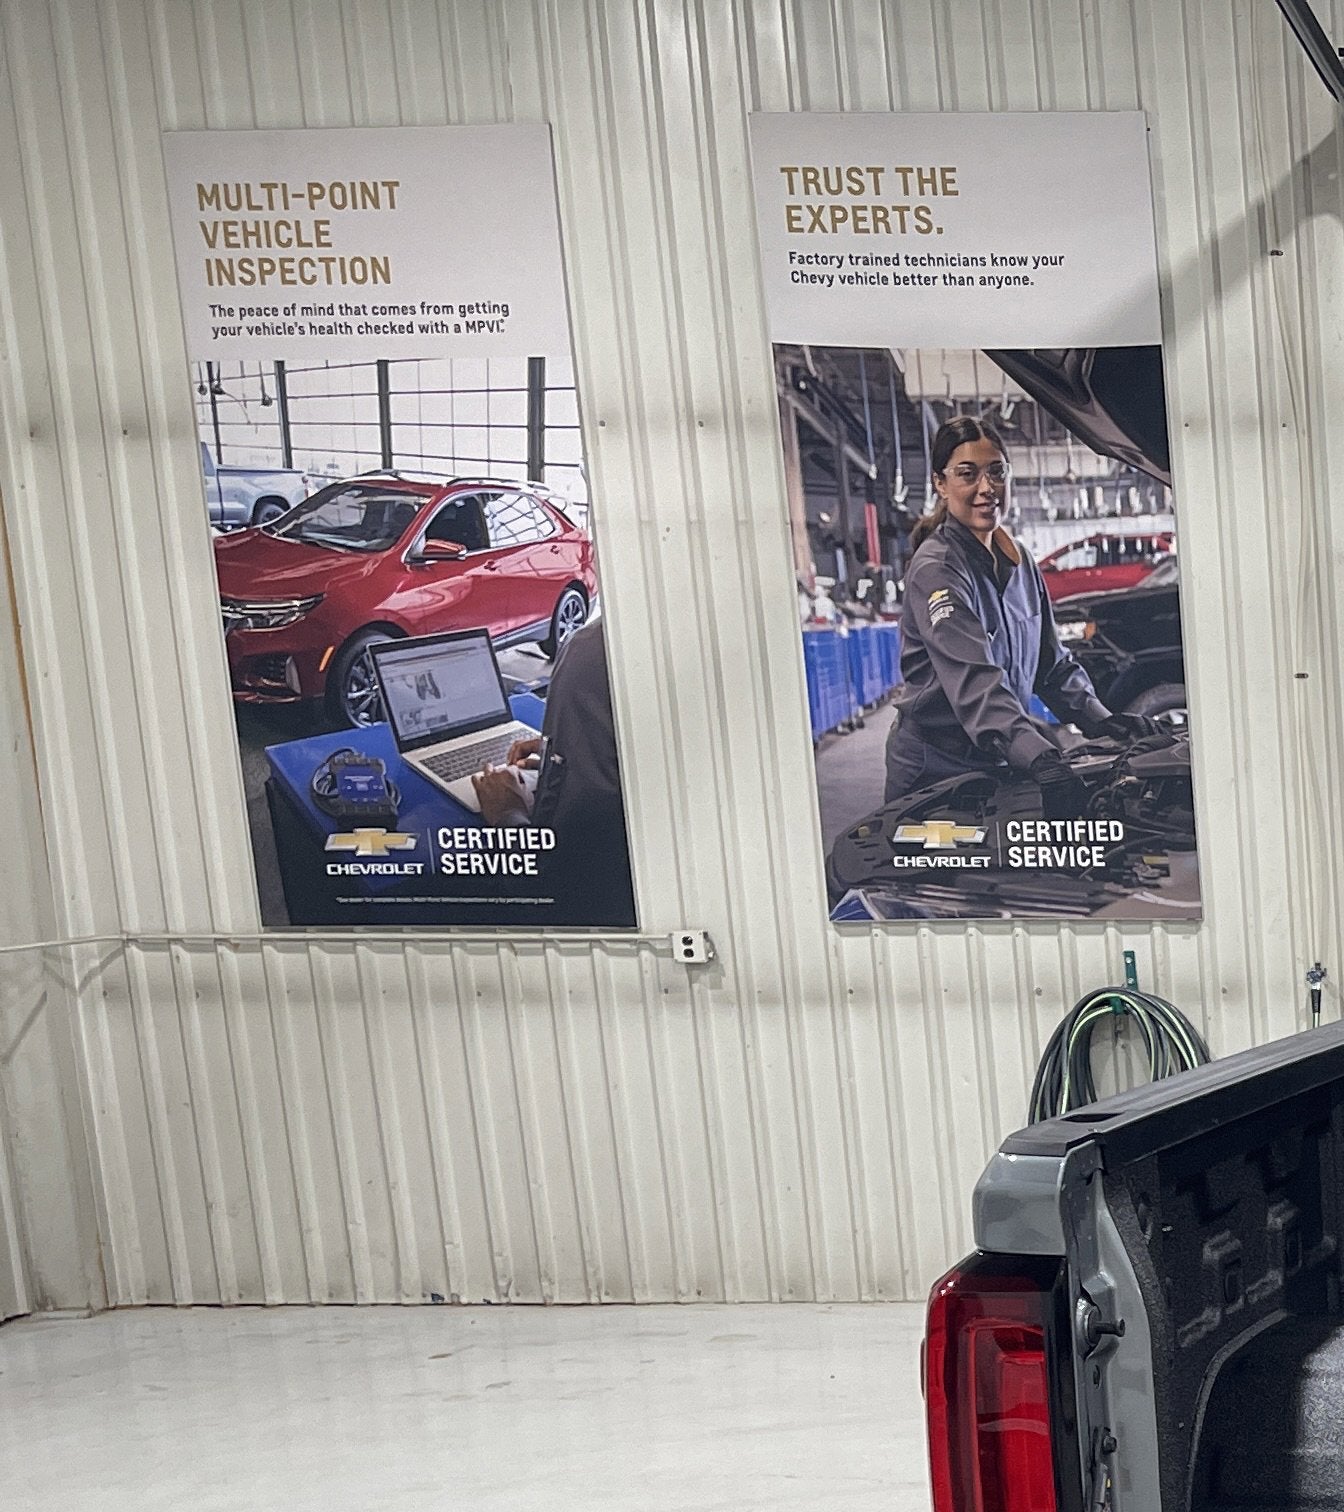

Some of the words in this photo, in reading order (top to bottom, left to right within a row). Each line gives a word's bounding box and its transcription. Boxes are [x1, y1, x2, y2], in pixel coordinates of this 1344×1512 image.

[780, 166, 885, 196] TRUST
[895, 166, 959, 197] THE
[196, 180, 400, 212] MULTI-POINT
[785, 204, 944, 235] EXPERTS.
[199, 219, 333, 249] VEHICLE
[205, 256, 392, 287] INSPECTION
[789, 251, 844, 269] Factory
[849, 252, 900, 267] trained
[904, 252, 987, 267] technicians
[991, 253, 1028, 267] know
[1032, 254, 1065, 269] your
[790, 270, 834, 287] Chevy
[838, 270, 889, 286] vehicle
[893, 271, 938, 286] better
[942, 272, 974, 286] than
[979, 274, 1034, 289] anyone.
[208, 304, 235, 318] The
[238, 305, 279, 320] peace
[283, 303, 297, 317] of
[300, 303, 334, 316] mind
[338, 302, 368, 316] that
[371, 304, 416, 316] comes
[420, 301, 454, 315] from
[458, 301, 510, 318] getting
[211, 325, 242, 340] your
[246, 321, 306, 336] vehicle's
[309, 321, 353, 336] health
[357, 320, 414, 335] checked
[418, 320, 449, 334] with
[453, 323, 462, 334] a
[437, 827, 556, 850] CERTIFIED
[1005, 820, 1124, 843] CERTIFIED
[440, 852, 539, 876] SERVICE
[893, 856, 991, 868] CHEVROLET
[1008, 846, 1106, 868] SERVICE
[326, 863, 425, 876] CHEVROLET
